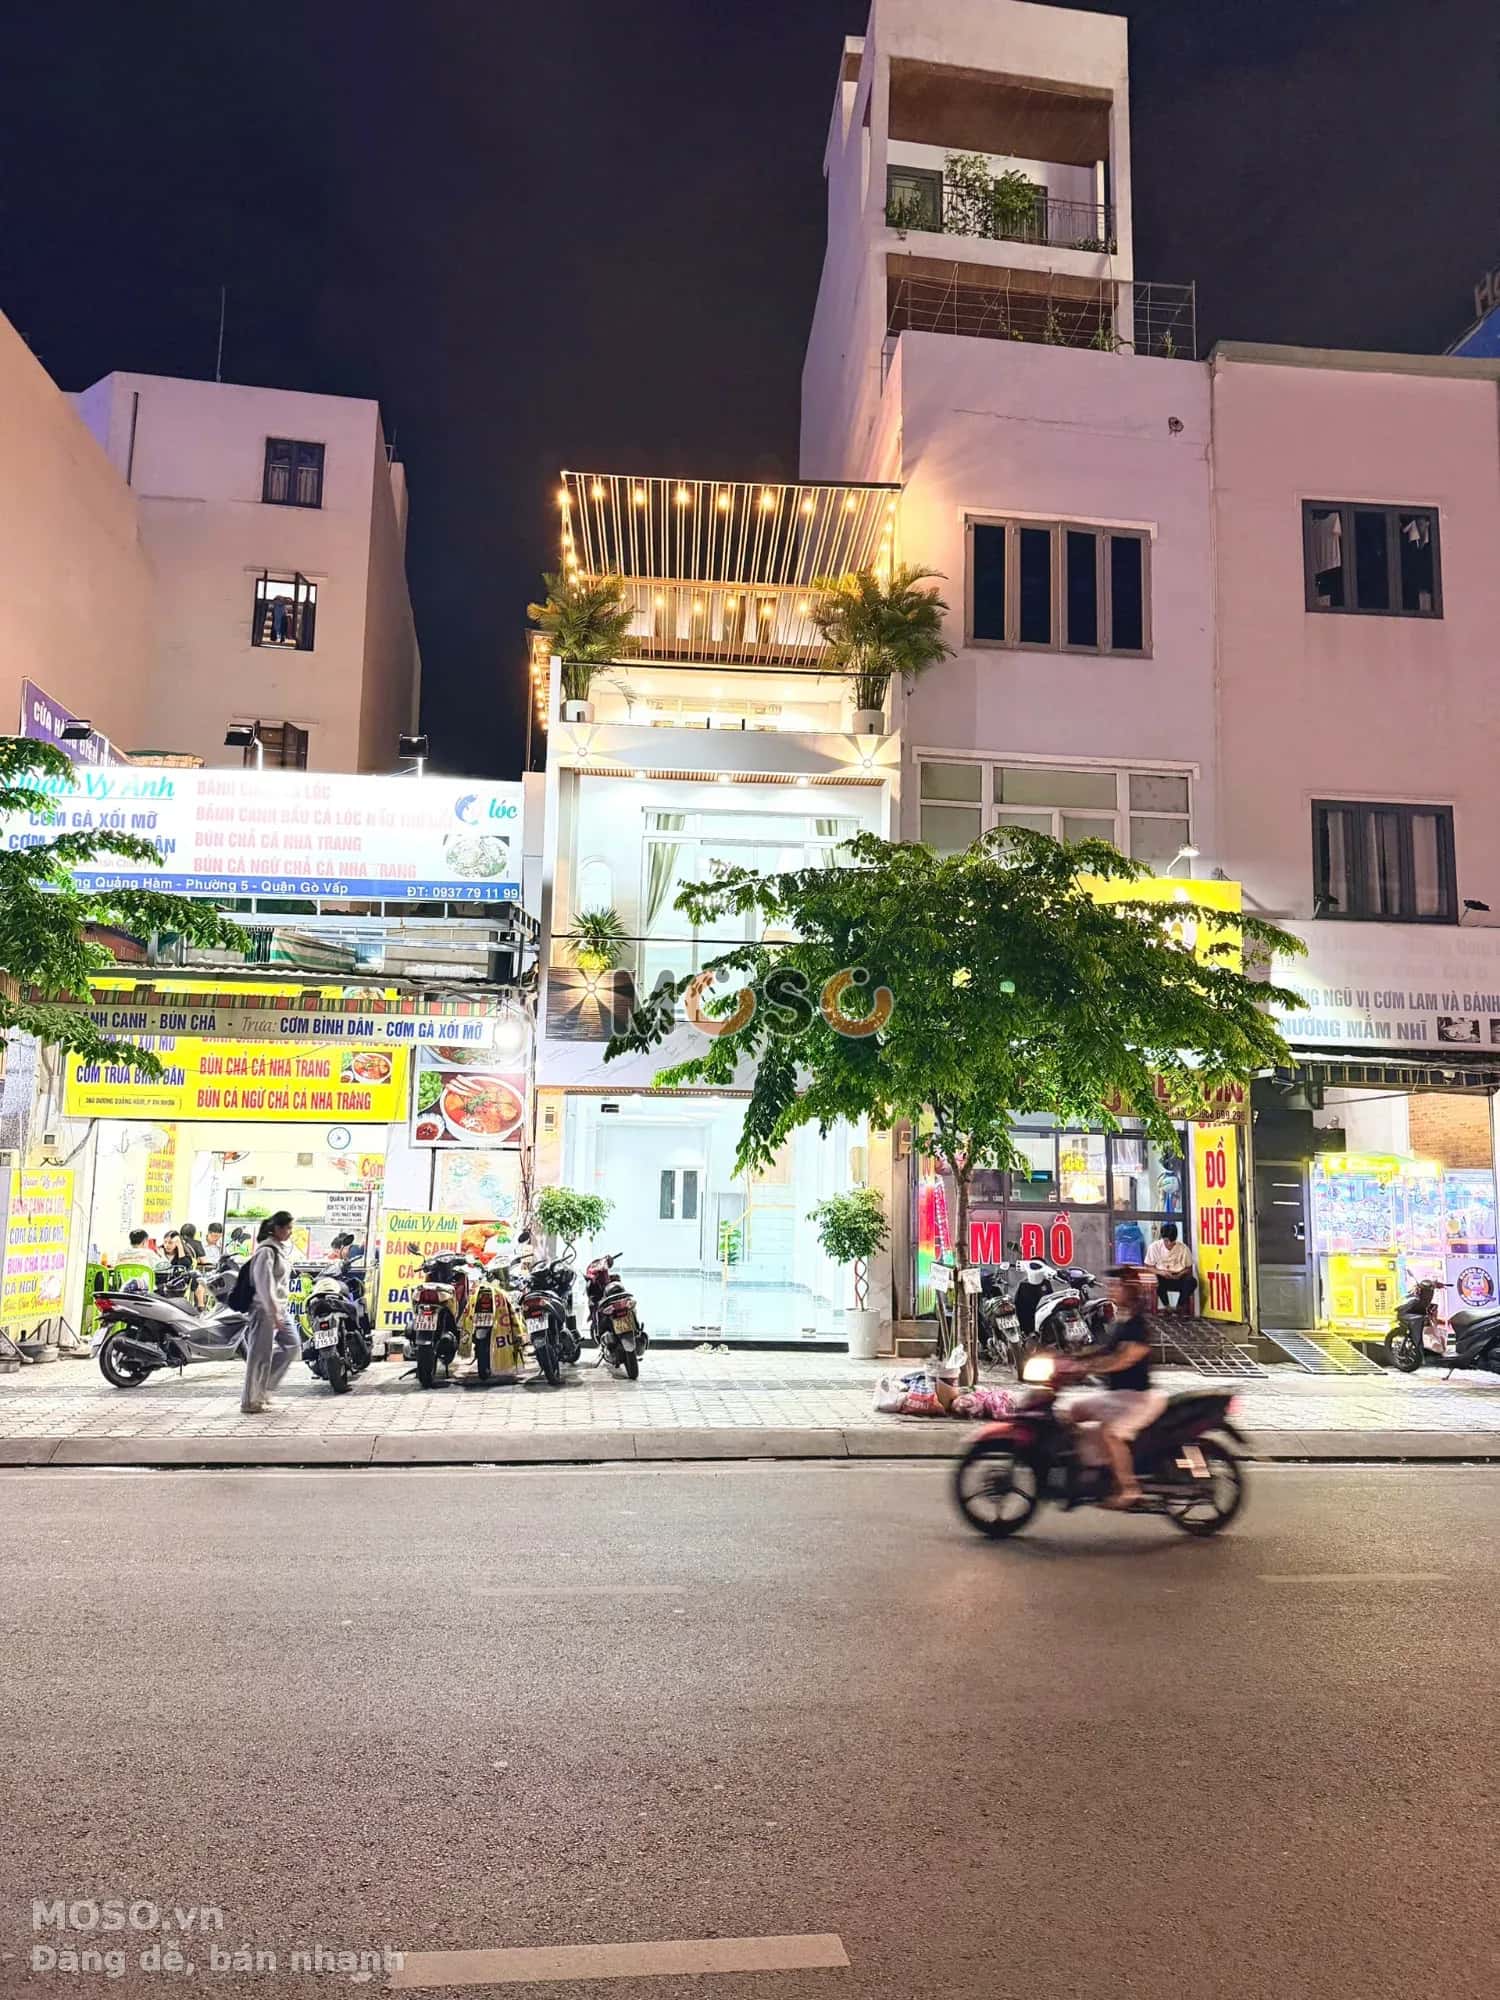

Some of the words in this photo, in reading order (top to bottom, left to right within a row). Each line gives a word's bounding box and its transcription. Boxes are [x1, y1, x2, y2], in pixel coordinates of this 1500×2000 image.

[488, 798, 518, 820] lóc
[148, 836, 176, 854] ÂN
[317, 835, 362, 853] TRANG
[143, 877, 173, 889] Hàm
[185, 877, 236, 892] Phường
[241, 880, 249, 890] 5
[261, 880, 296, 894] Quận
[300, 880, 320, 893] Gò
[323, 880, 348, 895] Vấp
[407, 886, 428, 897] ĐT:
[432, 887, 463, 897] 0937
[467, 887, 481, 898] 79
[486, 887, 499, 898] 11
[503, 888, 519, 898] 99
[1324, 986, 1352, 1008] NGŨ
[1356, 990, 1370, 1013] VỊ
[1374, 989, 1405, 1010] CƠM
[1409, 992, 1438, 1011] LAM
[1442, 989, 1460, 1012] VÀ
[1463, 989, 1500, 1013] BÁNH
[112, 1011, 147, 1028] CANH
[160, 1010, 187, 1029] BÚN
[191, 1010, 216, 1031] CHẢ
[280, 1016, 306, 1034] CƠM
[313, 1017, 343, 1035] BÌNH
[347, 1018, 374, 1037] DÂN
[386, 1020, 414, 1038] CƠM
[418, 1020, 436, 1039] GÀ
[438, 1019, 459, 1039] XỐI
[463, 1020, 484, 1041] MỠ
[1397, 1019, 1427, 1041] NHĨ
[163, 1064, 185, 1086] DÂN
[200, 1053, 223, 1075] BÚN
[226, 1051, 248, 1076] CHẢ
[251, 1053, 266, 1076] CÁ
[269, 1057, 291, 1078] NHA
[295, 1057, 330, 1079] TRANG
[197, 1086, 220, 1107] BÚN
[223, 1086, 238, 1108] CÁ
[241, 1086, 266, 1109] NGỪ
[267, 1085, 290, 1109] CHẢ
[292, 1087, 308, 1109] CÁ
[310, 1091, 334, 1110] NHA
[337, 1091, 372, 1111] TRANG
[1205, 1136, 1227, 1189] ĐỒ
[390, 1213, 419, 1233] Quán
[421, 1214, 436, 1233] Vy
[437, 1216, 458, 1231] Anh
[1200, 1198, 1235, 1255] HIỆP
[1207, 1263, 1233, 1314] TÍN
